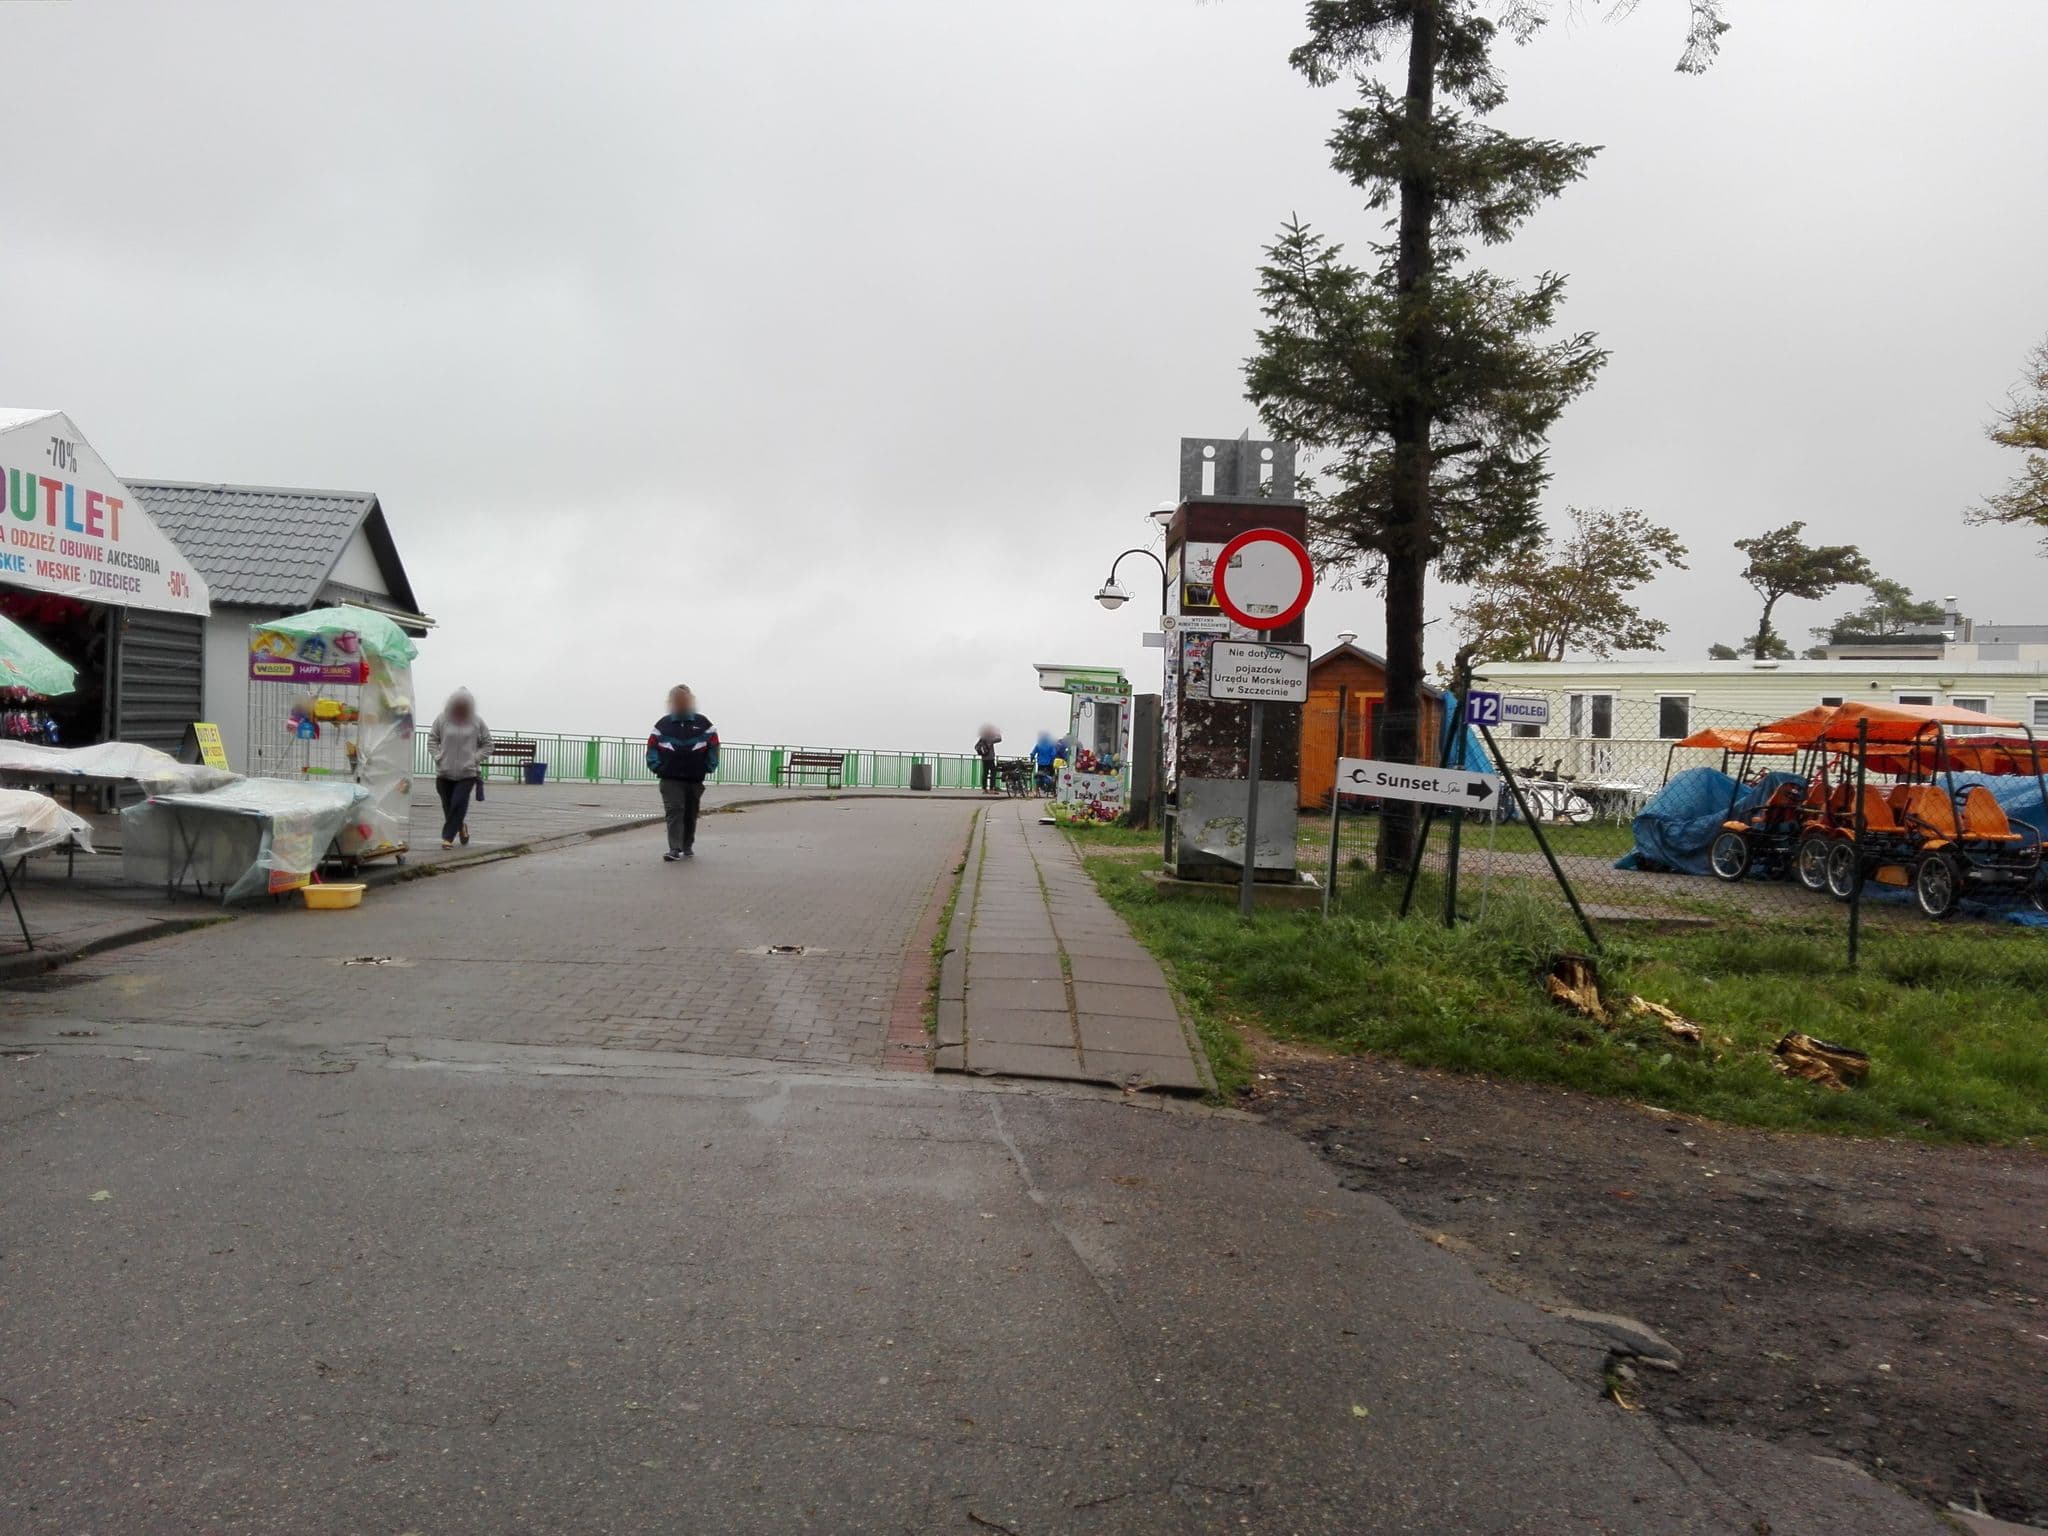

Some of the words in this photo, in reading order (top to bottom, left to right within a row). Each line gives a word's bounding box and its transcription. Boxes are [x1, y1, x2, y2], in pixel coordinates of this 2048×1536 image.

[46, 436, 77, 473] -70%
[0, 464, 124, 542] UTLET
[11, 527, 55, 552] ODZIEŻ
[60, 539, 103, 562] OBUWIE
[107, 548, 160, 575] AKCESORIA
[36, 559, 81, 582] MĘSKIE
[89, 569, 141, 595] DZIECIĘCE
[1229, 648, 1245, 657] Nie
[1248, 649, 1286, 661] dotyczy
[1235, 665, 1282, 675] pojazdów
[1214, 674, 1248, 684] Urzędu
[1251, 676, 1302, 688] Morskiego
[1238, 685, 1289, 696] Szczecinie
[1470, 697, 1498, 721] 12
[1504, 704, 1547, 717] NOCLEGI
[1376, 772, 1440, 792] Sunset
